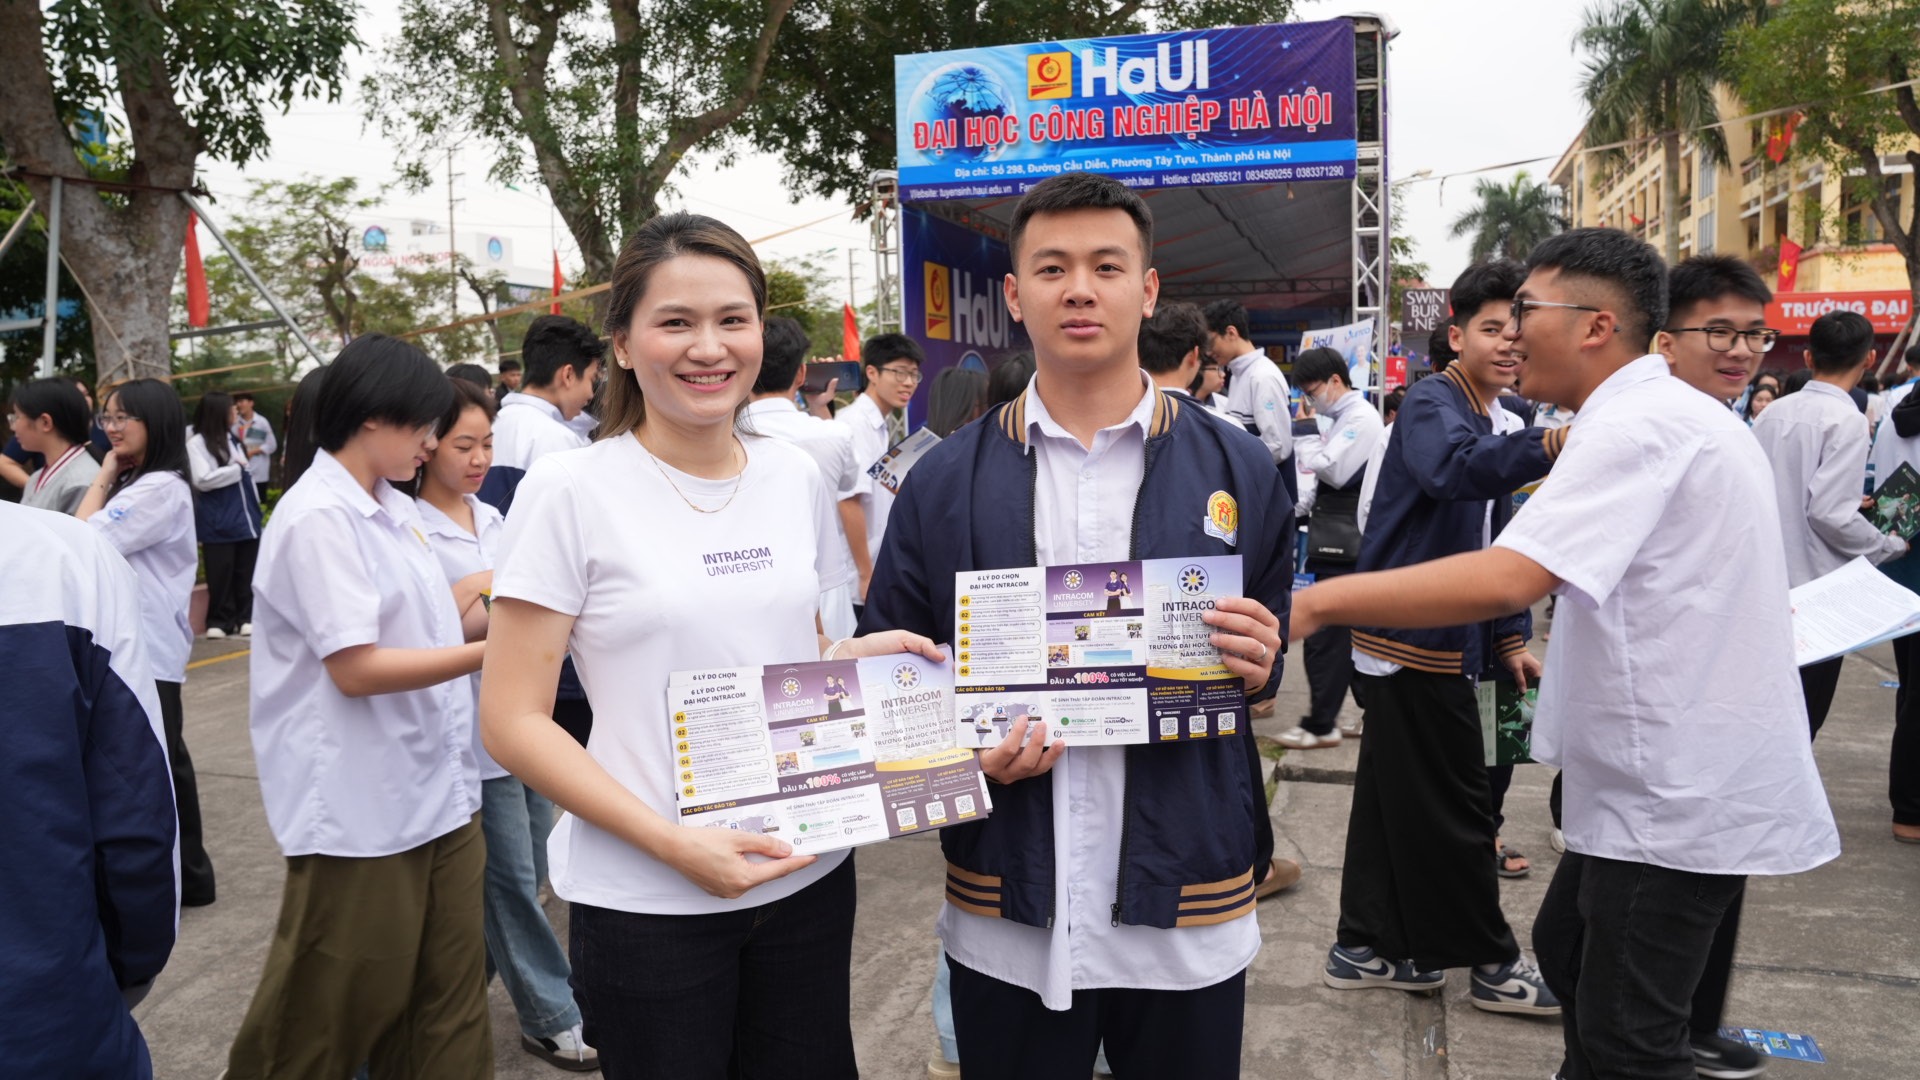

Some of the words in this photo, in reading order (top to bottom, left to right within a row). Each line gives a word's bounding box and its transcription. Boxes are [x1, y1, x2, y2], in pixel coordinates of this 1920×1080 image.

[1081, 39, 1209, 97] HaUI
[914, 119, 957, 156] ĐẠI
[965, 115, 1018, 151] HỌC
[1028, 105, 1104, 143] CÔNG
[1113, 96, 1221, 139] NGHIỆP
[1229, 91, 1269, 130] HÀ
[1280, 86, 1332, 132] NỘI
[955, 168, 971, 180] Địa
[991, 165, 1004, 177] Số
[1006, 165, 1025, 176] 298,
[1028, 163, 1062, 176] Đường
[1063, 160, 1082, 172] Cầu
[1084, 158, 1109, 171] Diễn,
[1112, 156, 1152, 169] Phường
[1154, 155, 1172, 167] Tây
[1174, 154, 1198, 167] Tựu,
[1200, 152, 1232, 165] Thành
[1234, 151, 1255, 166] phố
[1257, 150, 1271, 162] Hà
[1273, 148, 1291, 160] Nội
[940, 184, 1012, 200] tuyensinh.haui.edu.vn
[1162, 173, 1190, 188] Hotline:
[1191, 170, 1242, 186] 02437655121
[1246, 168, 1292, 182] 0834560255
[1296, 165, 1344, 180] 0383371290
[1406, 291, 1445, 305] SWIN
[953, 268, 1008, 348] HaUI
[1412, 304, 1440, 318] BUR
[1781, 298, 1866, 317] TRƯỜNG
[1871, 299, 1908, 320] ĐẠI
[1312, 334, 1334, 348] HaUI
[702, 547, 772, 565] INTRACOM
[706, 559, 774, 577] UNIVERSITY
[983, 574, 990, 582] LÝ
[1001, 573, 1020, 582] CHỌN
[982, 582, 995, 590] HỌC
[996, 581, 1029, 589] INTRACOM
[1054, 592, 1094, 602] INTRACOM
[1054, 600, 1094, 609] UNIVERSITY
[1162, 600, 1215, 612] INTRACO
[1162, 612, 1203, 623] UNIVER
[1149, 642, 1178, 650] TRƯỜNG
[1180, 642, 1191, 650] ĐẠI
[1193, 642, 1206, 650] HỌC
[1180, 650, 1196, 658] NĂM
[698, 673, 707, 681] LÝ
[718, 672, 737, 681] CHỌN
[1050, 676, 1064, 686] ĐẦU
[1066, 678, 1075, 686] RA
[1075, 672, 1110, 686] 100%
[696, 687, 706, 696] LÝ
[716, 684, 736, 694] CHỌN
[684, 698, 696, 707] ĐẠI
[696, 696, 711, 706] HỌC
[712, 692, 746, 702] INTRACOM
[773, 698, 814, 710] INTRACOM
[881, 690, 942, 709] INTRACOM
[774, 706, 816, 717] UNIVERSITY
[882, 701, 943, 720] UNIVERSITY
[676, 714, 684, 722] 01
[881, 728, 903, 737] THÔNG
[905, 726, 915, 734] TIN
[917, 721, 937, 732] TUYỂN
[938, 718, 954, 727] SINH
[874, 736, 902, 747] TRƯỜNG
[903, 734, 914, 744] ĐẠI
[916, 732, 929, 742] HỌC
[905, 740, 921, 750] NĂM
[922, 738, 937, 747] 2026
[681, 758, 689, 766] 04
[782, 783, 797, 793] ĐẦU
[798, 783, 808, 792] RA
[806, 774, 841, 790] 100%
[840, 793, 865, 802] INTRACOM
